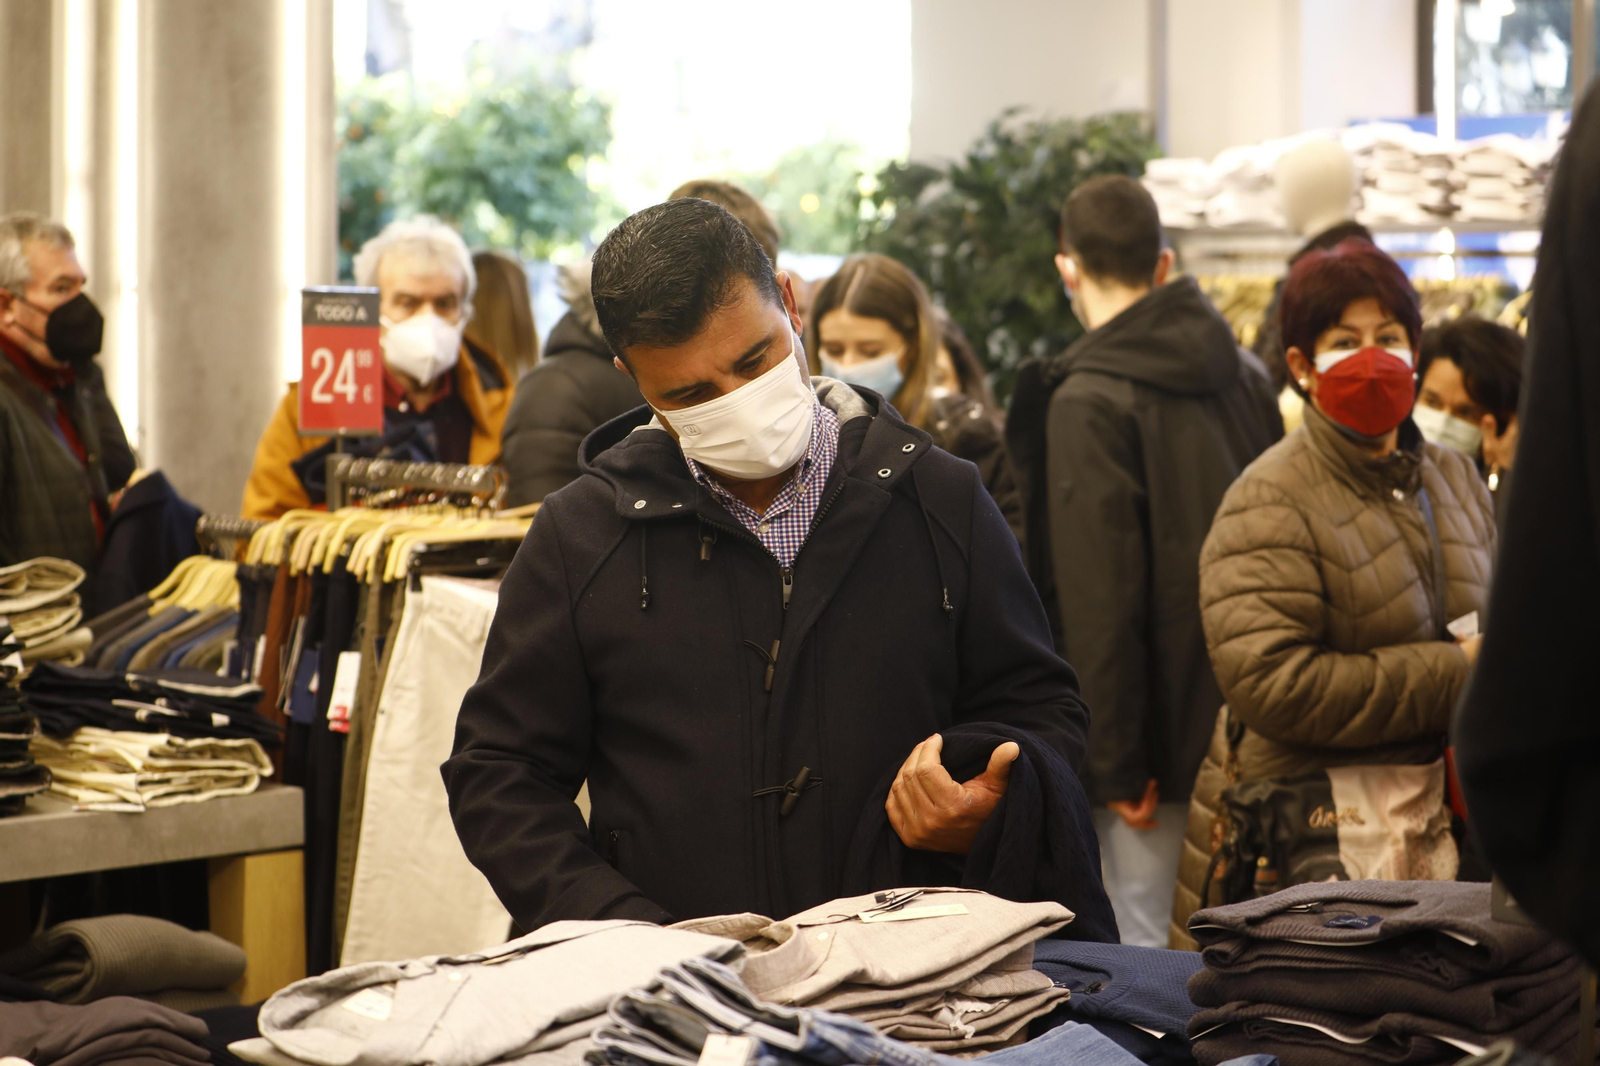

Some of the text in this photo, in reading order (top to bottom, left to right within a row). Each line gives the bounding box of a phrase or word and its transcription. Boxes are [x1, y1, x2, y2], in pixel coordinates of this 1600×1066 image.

[315, 304, 369, 322] TODO A
[311, 347, 358, 404] 24
